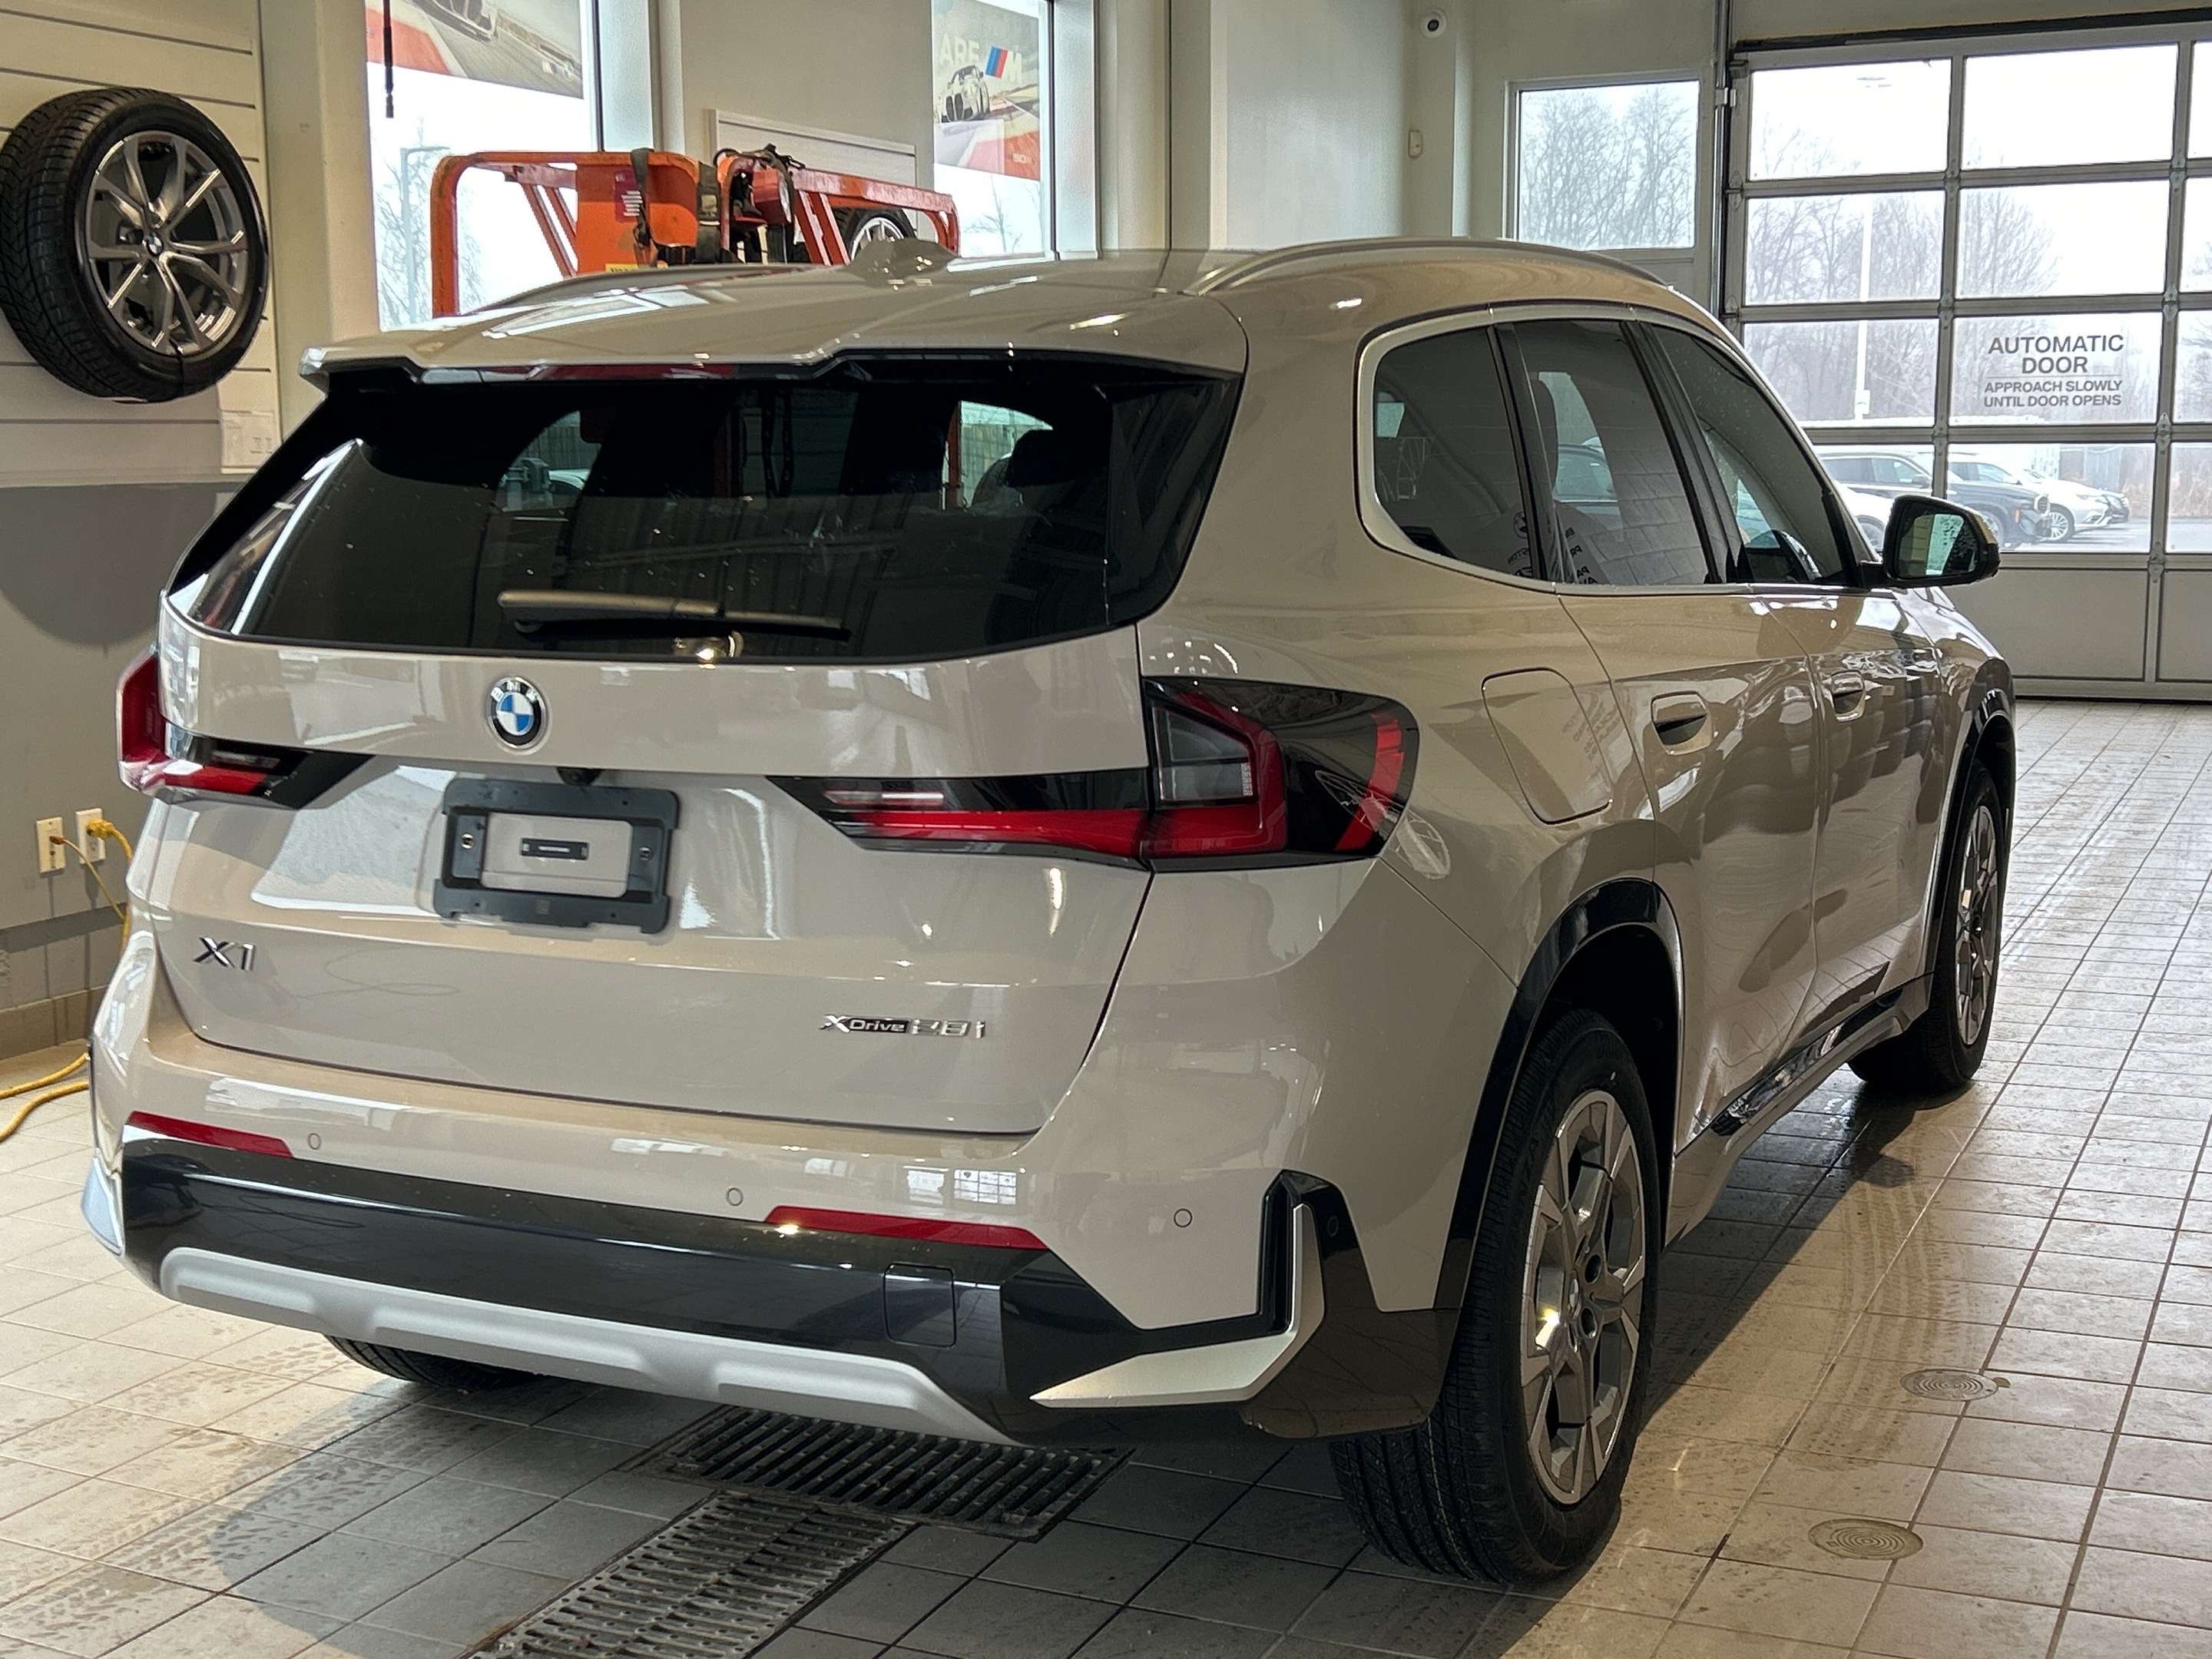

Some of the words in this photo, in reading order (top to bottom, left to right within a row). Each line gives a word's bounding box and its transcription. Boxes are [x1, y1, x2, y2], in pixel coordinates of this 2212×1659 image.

[1988, 335, 2124, 355] AUTOMATIC
[2022, 356, 2088, 374] DOOR
[1985, 380, 2062, 393] APPROACH
[2065, 379, 2122, 392] SLOWLY
[1984, 396, 2025, 407] UNTIL
[2028, 396, 2068, 406] DOOR
[2072, 394, 2121, 406] OPENS
[491, 680, 539, 704] BMW
[193, 935, 256, 971] X1
